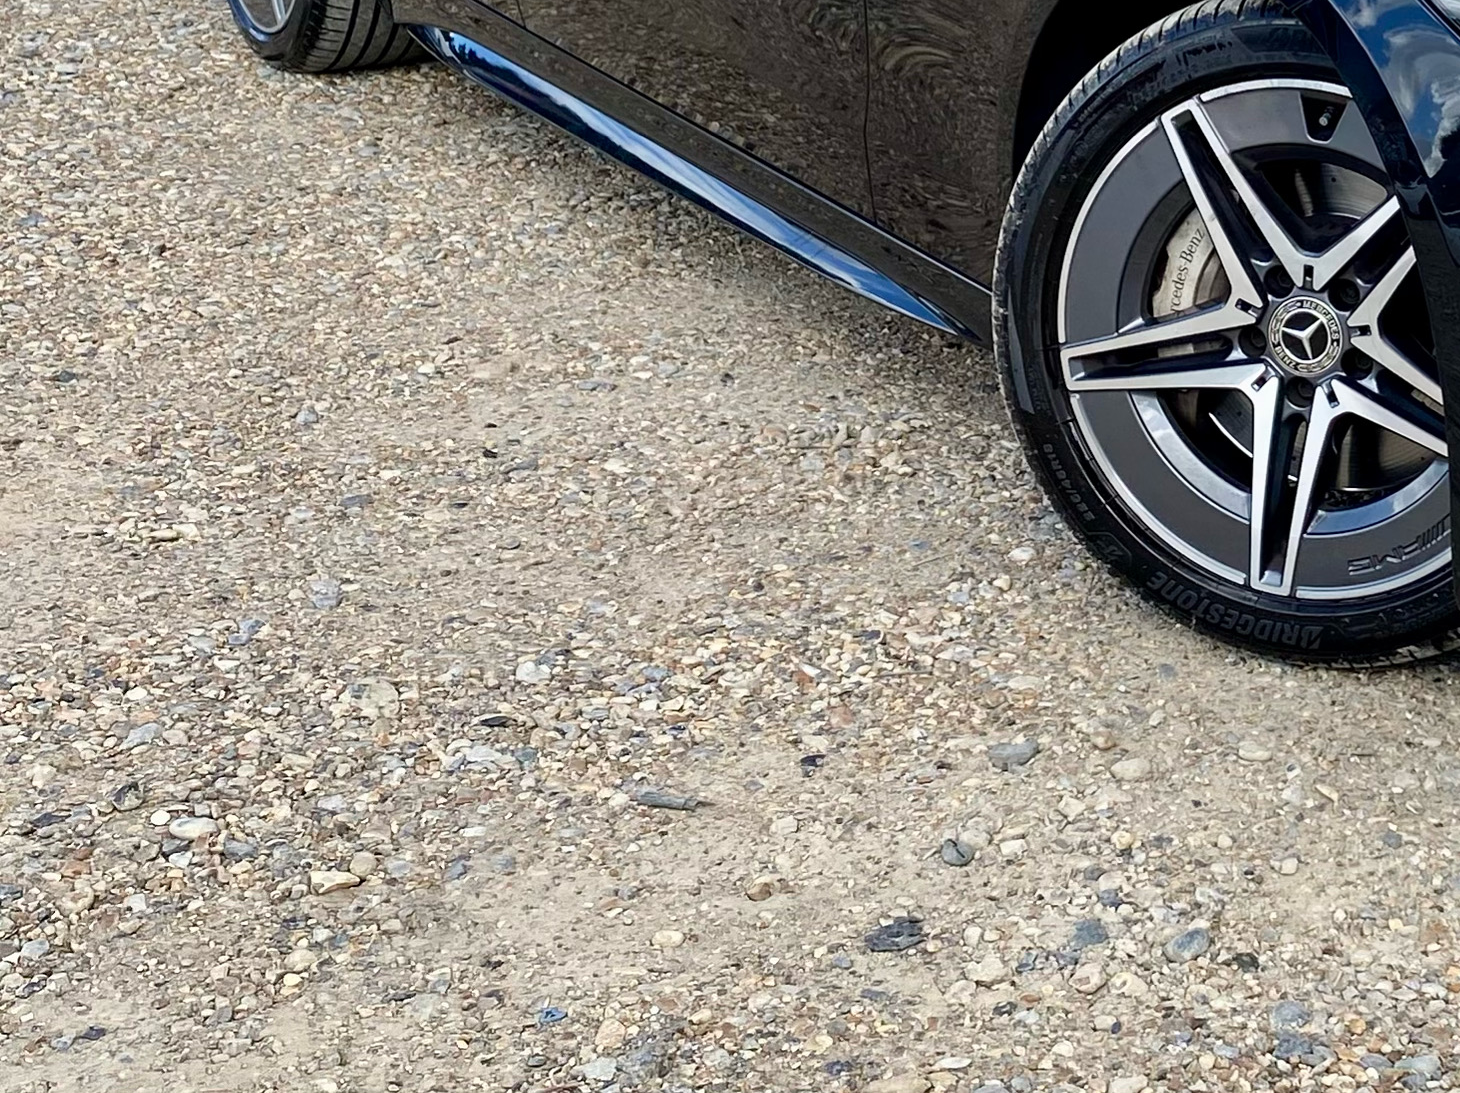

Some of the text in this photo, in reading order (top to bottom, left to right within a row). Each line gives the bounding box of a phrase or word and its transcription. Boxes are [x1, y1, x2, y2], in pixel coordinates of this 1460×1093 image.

[1302, 300, 1340, 340] MERCEDES
[1274, 346, 1297, 368] BENZ
[1146, 571, 1325, 650] BRIDGESTONE
